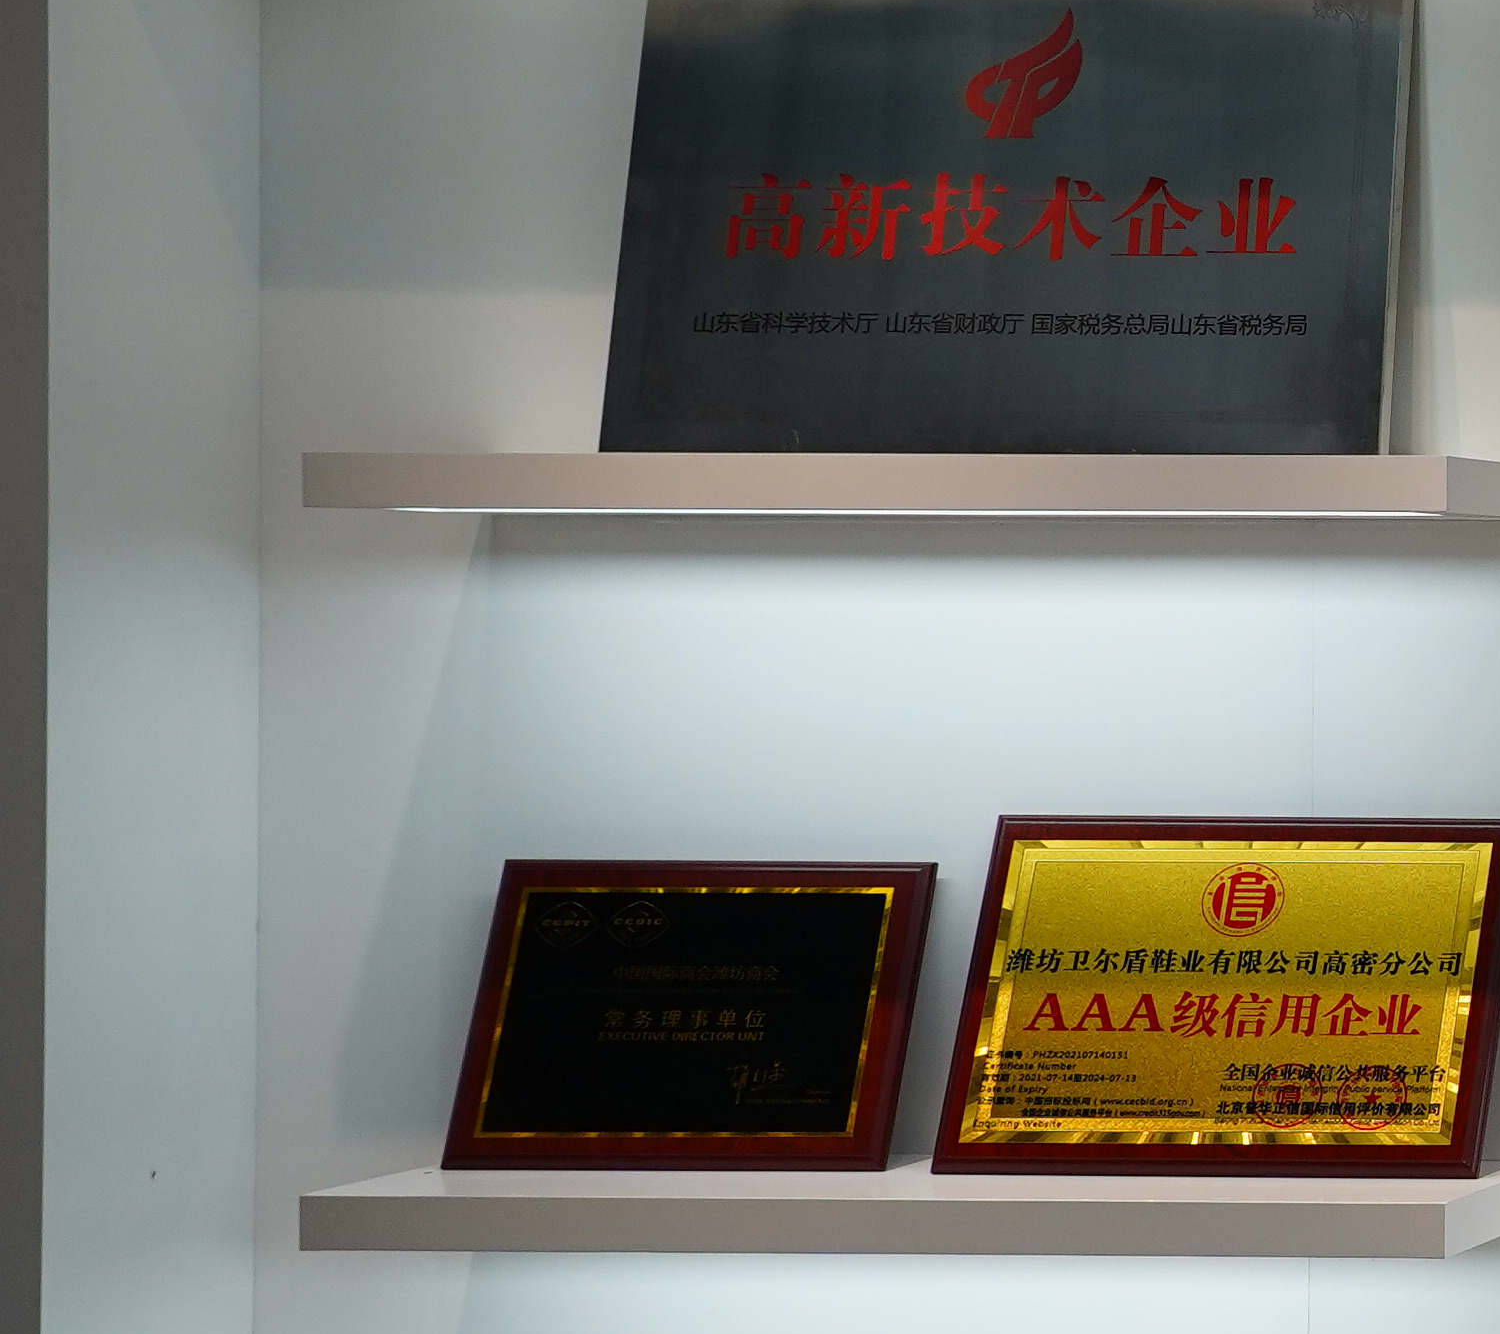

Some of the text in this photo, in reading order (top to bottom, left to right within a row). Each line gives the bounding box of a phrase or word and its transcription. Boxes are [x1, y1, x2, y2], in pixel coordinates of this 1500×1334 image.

[726, 172, 1299, 261] 高新技术企业
[693, 312, 1308, 337] 山东省科学技术厅 山东省财政厅 国家税务总局山东省税务局
[1006, 948, 1463, 977] 潍坊卫尔盾鞋业有限公司高密分公司
[604, 1009, 767, 1029] 常务理事单位
[1024, 991, 1422, 1038] AAA级信用企业
[597, 1032, 667, 1041] EXECUTIVE
[671, 1032, 734, 1041] DIRECTOR
[1223, 1063, 1445, 1082] 全国企业诚信公共服务平台
